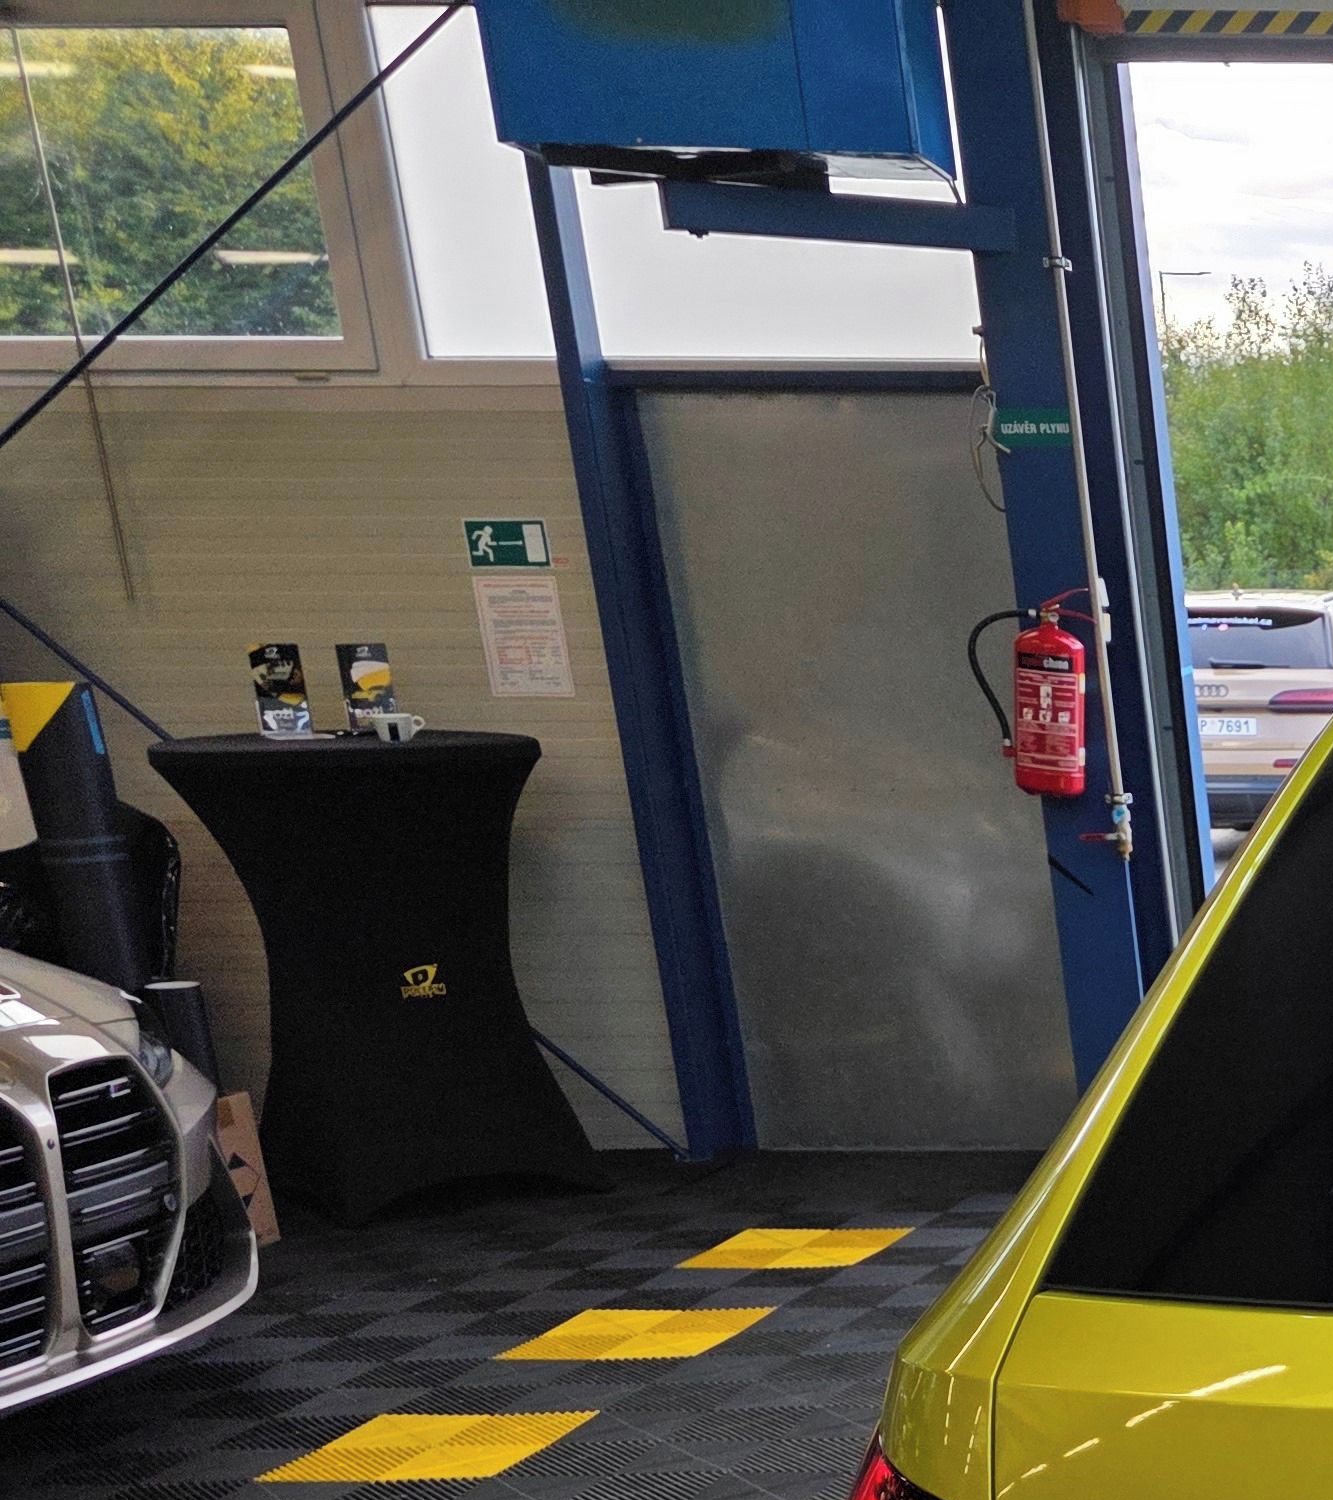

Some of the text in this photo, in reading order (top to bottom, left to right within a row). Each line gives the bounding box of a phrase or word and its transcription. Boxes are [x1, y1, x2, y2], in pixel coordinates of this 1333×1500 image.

[1001, 421, 1070, 434] UZÁVĚR PLYNU
[1218, 719, 1250, 733] 7691
